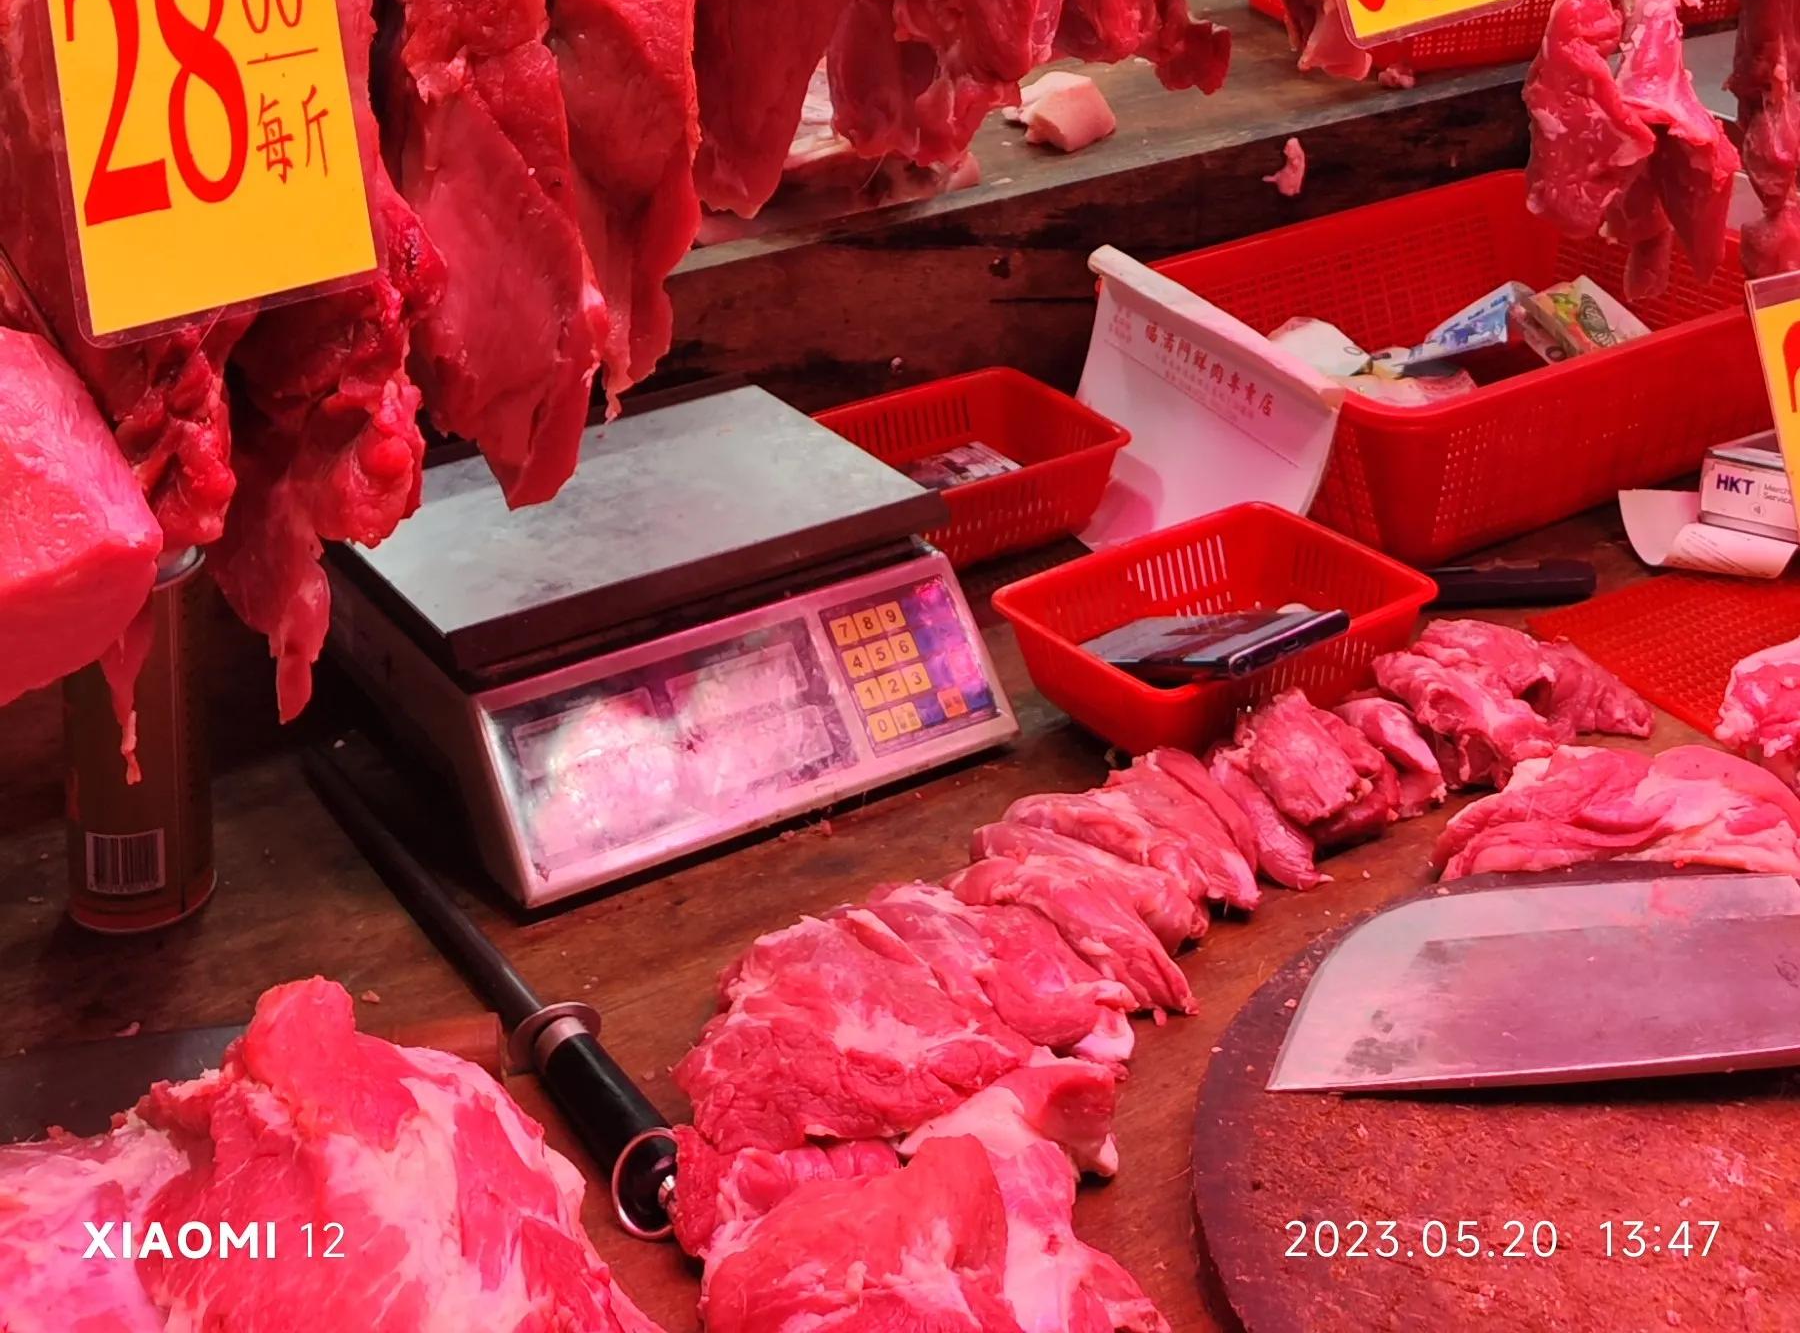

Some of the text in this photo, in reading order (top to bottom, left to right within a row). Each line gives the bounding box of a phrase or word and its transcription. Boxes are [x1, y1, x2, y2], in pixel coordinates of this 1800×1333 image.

[255, 85, 329, 184] 每斤
[1716, 473, 1755, 495] HKT
[838, 609, 896, 637] 7 8 9
[852, 640, 910, 669] 4 5 6
[864, 671, 922, 700] 1 2 3
[877, 719, 888, 733] 0
